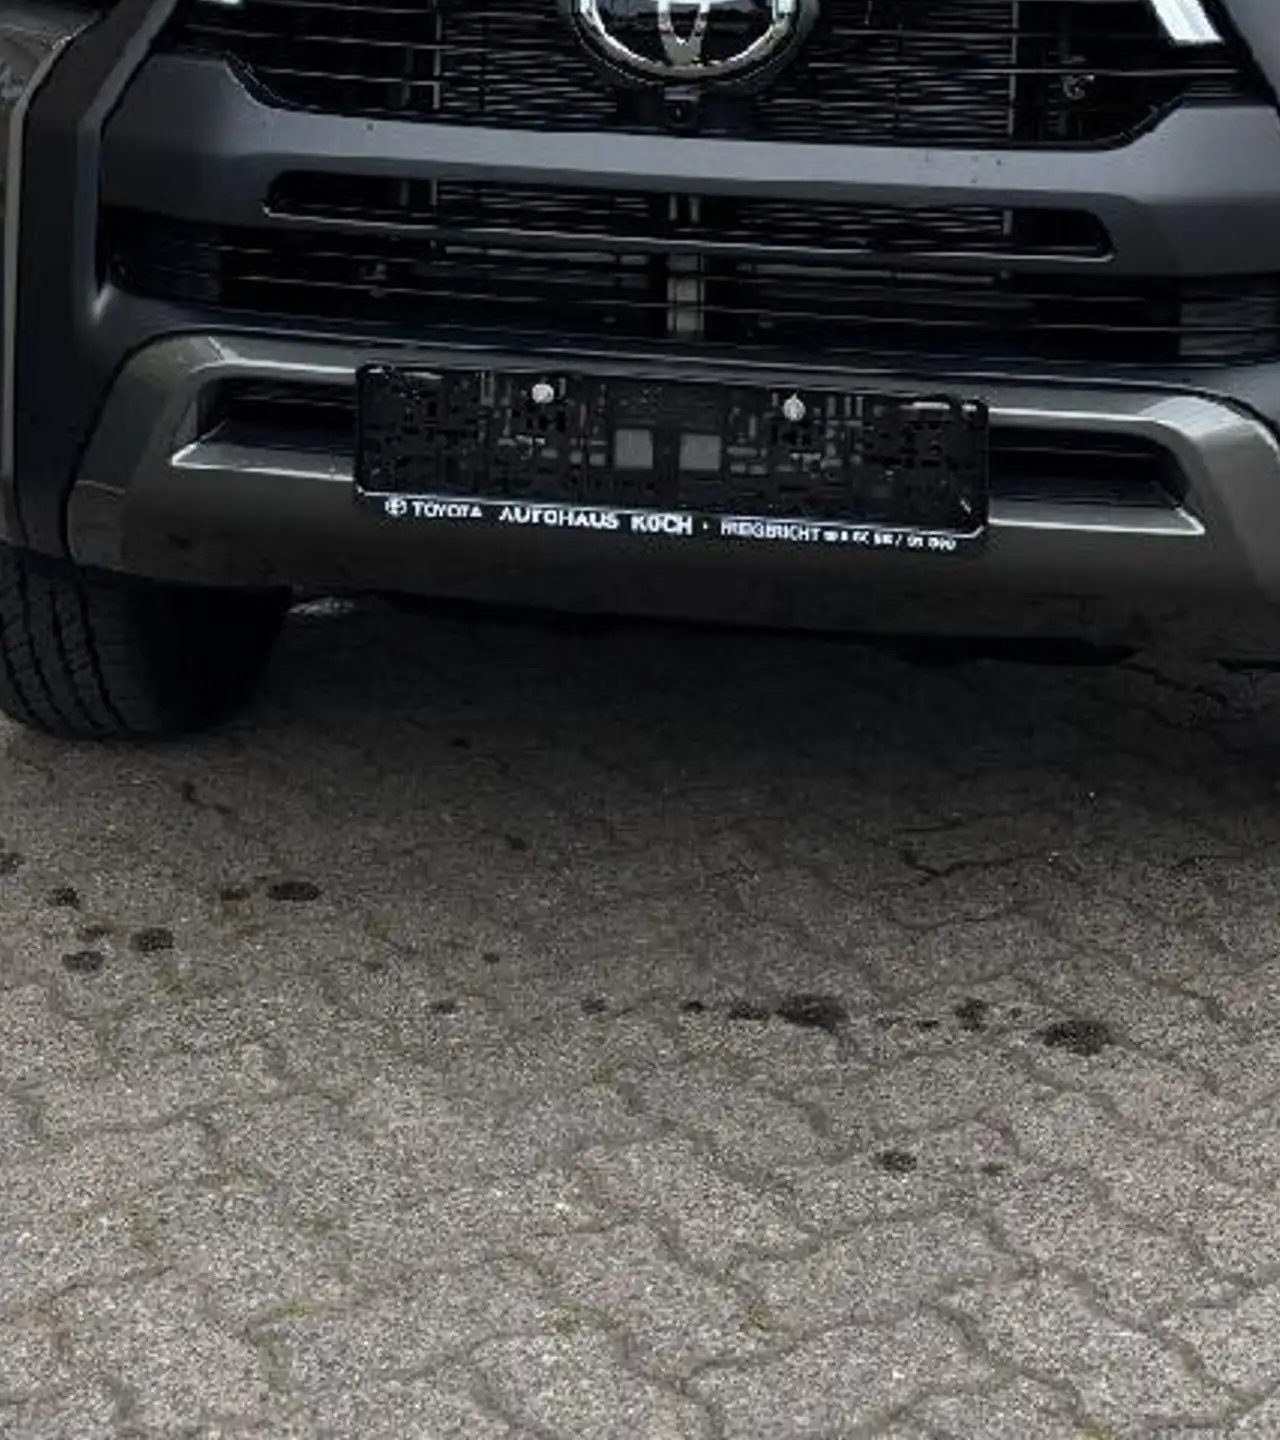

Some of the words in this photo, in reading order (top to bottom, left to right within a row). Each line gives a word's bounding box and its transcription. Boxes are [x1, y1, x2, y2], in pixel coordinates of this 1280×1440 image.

[411, 501, 483, 518] TOYOTA
[498, 506, 620, 530] AUTOHAUS
[630, 513, 693, 536] KOCH
